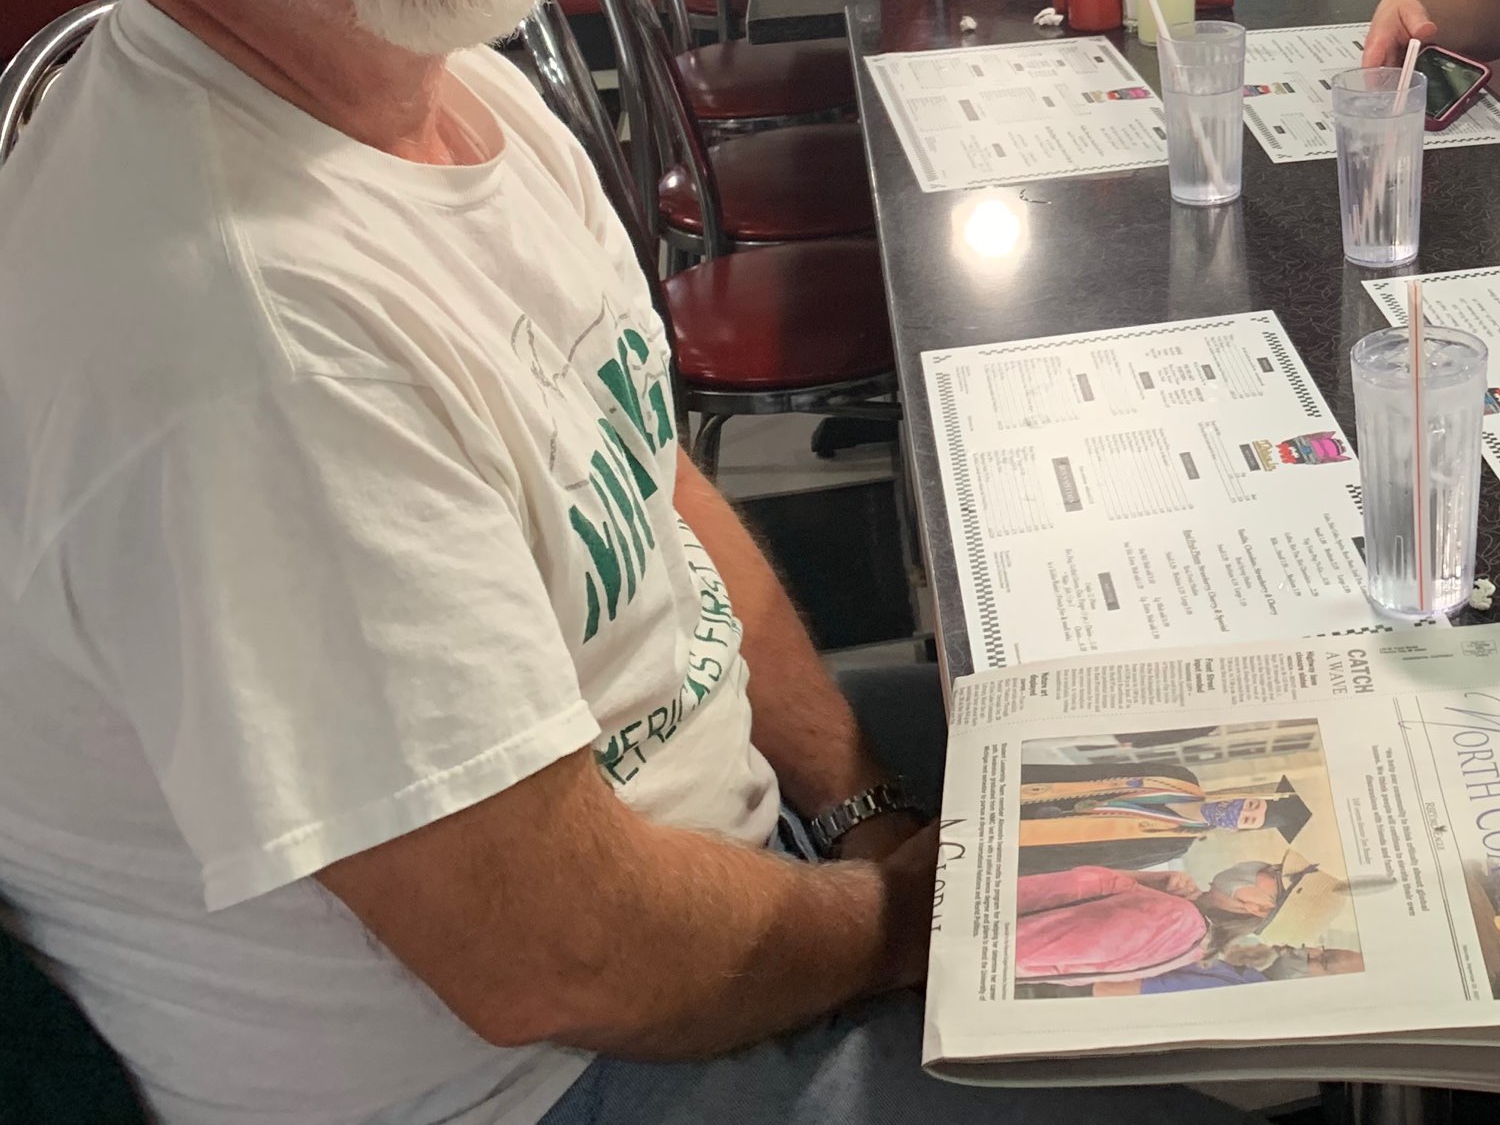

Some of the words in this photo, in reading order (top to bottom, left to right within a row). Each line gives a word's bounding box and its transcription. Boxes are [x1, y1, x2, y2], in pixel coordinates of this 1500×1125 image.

[688, 559, 734, 649] FIRST
[1204, 657, 1214, 672] Front
[1294, 651, 1305, 671] closure
[1303, 650, 1317, 673] Highway
[1324, 650, 1340, 660] A
[1192, 658, 1202, 673] input
[1345, 647, 1375, 694] CATCH
[1029, 674, 1038, 696] displayed
[1040, 672, 1048, 688] Nature
[1194, 672, 1205, 693] needed
[1206, 673, 1216, 691] Street
[1298, 671, 1309, 688] slated
[1309, 673, 1319, 686] lane
[1326, 660, 1348, 695] WAVE
[981, 745, 989, 764] Michigan
[998, 759, 1006, 783] Leadership
[1386, 759, 1397, 773] help
[988, 777, 996, 799] graduated
[1376, 775, 1389, 792] think
[1389, 773, 1400, 785] our
[1364, 774, 1380, 811] discussions
[1392, 785, 1408, 818] community
[1380, 793, 1394, 814] people
[1372, 811, 1383, 823] with
[1385, 814, 1396, 825] will
[1374, 823, 1388, 846] friends
[1387, 825, 1402, 852] continue
[1401, 825, 1413, 841] think
[1379, 846, 1390, 858] and
[984, 858, 992, 875] political
[1394, 859, 1409, 882] elevate
[975, 869, 983, 890] Relations
[1410, 866, 1424, 888] about
[992, 888, 1000, 910] program
[1400, 883, 1413, 900] their
[1415, 888, 1429, 912] global
[973, 900, 981, 915] World
[982, 894, 990, 912] degree
[1403, 900, 1417, 916] own
[972, 915, 980, 937] Politics.
[980, 924, 989, 939] plans
[991, 920, 999, 940] helping
[990, 949, 998, 973] determine
[977, 969, 986, 994] University
